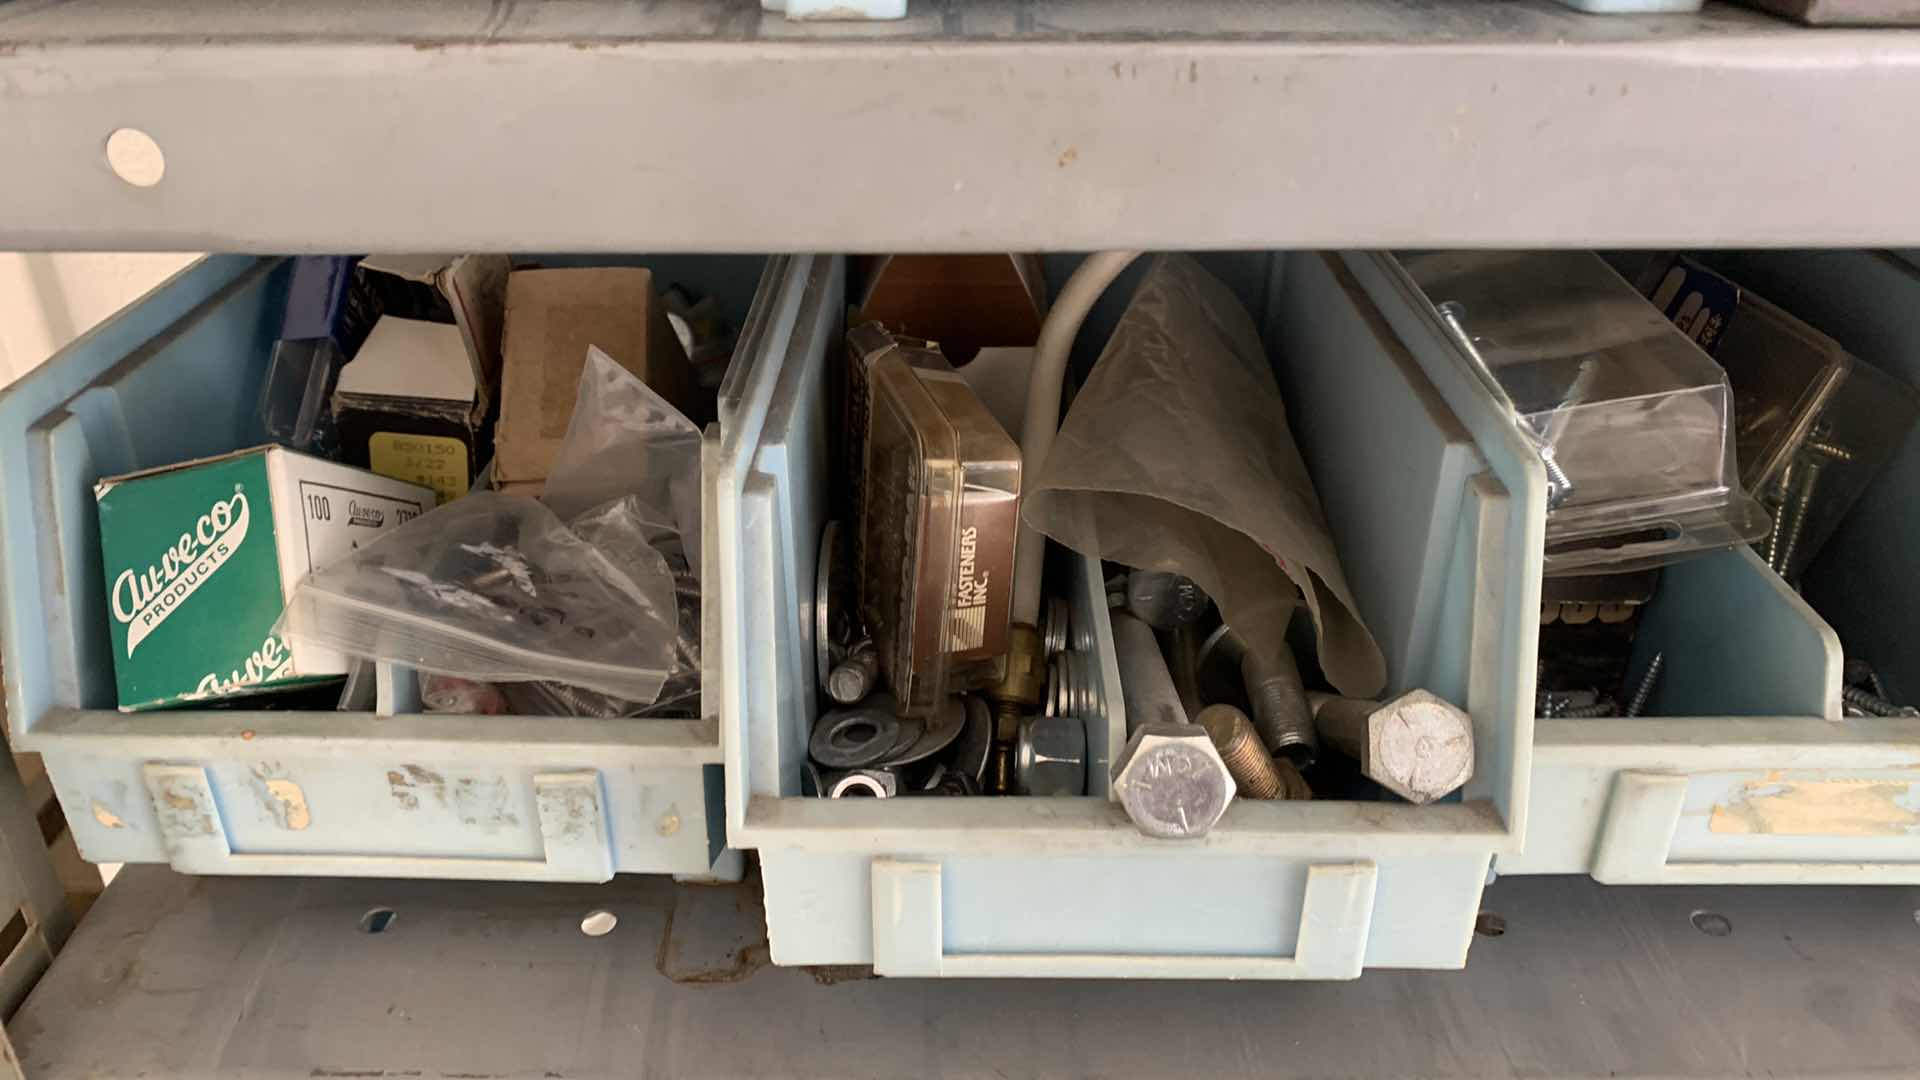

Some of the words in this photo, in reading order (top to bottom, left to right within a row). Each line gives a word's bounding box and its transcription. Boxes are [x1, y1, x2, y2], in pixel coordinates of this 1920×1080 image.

[306, 492, 331, 521] 100
[142, 542, 230, 626] PRODUCTS
[958, 526, 977, 607] FASTENERS
